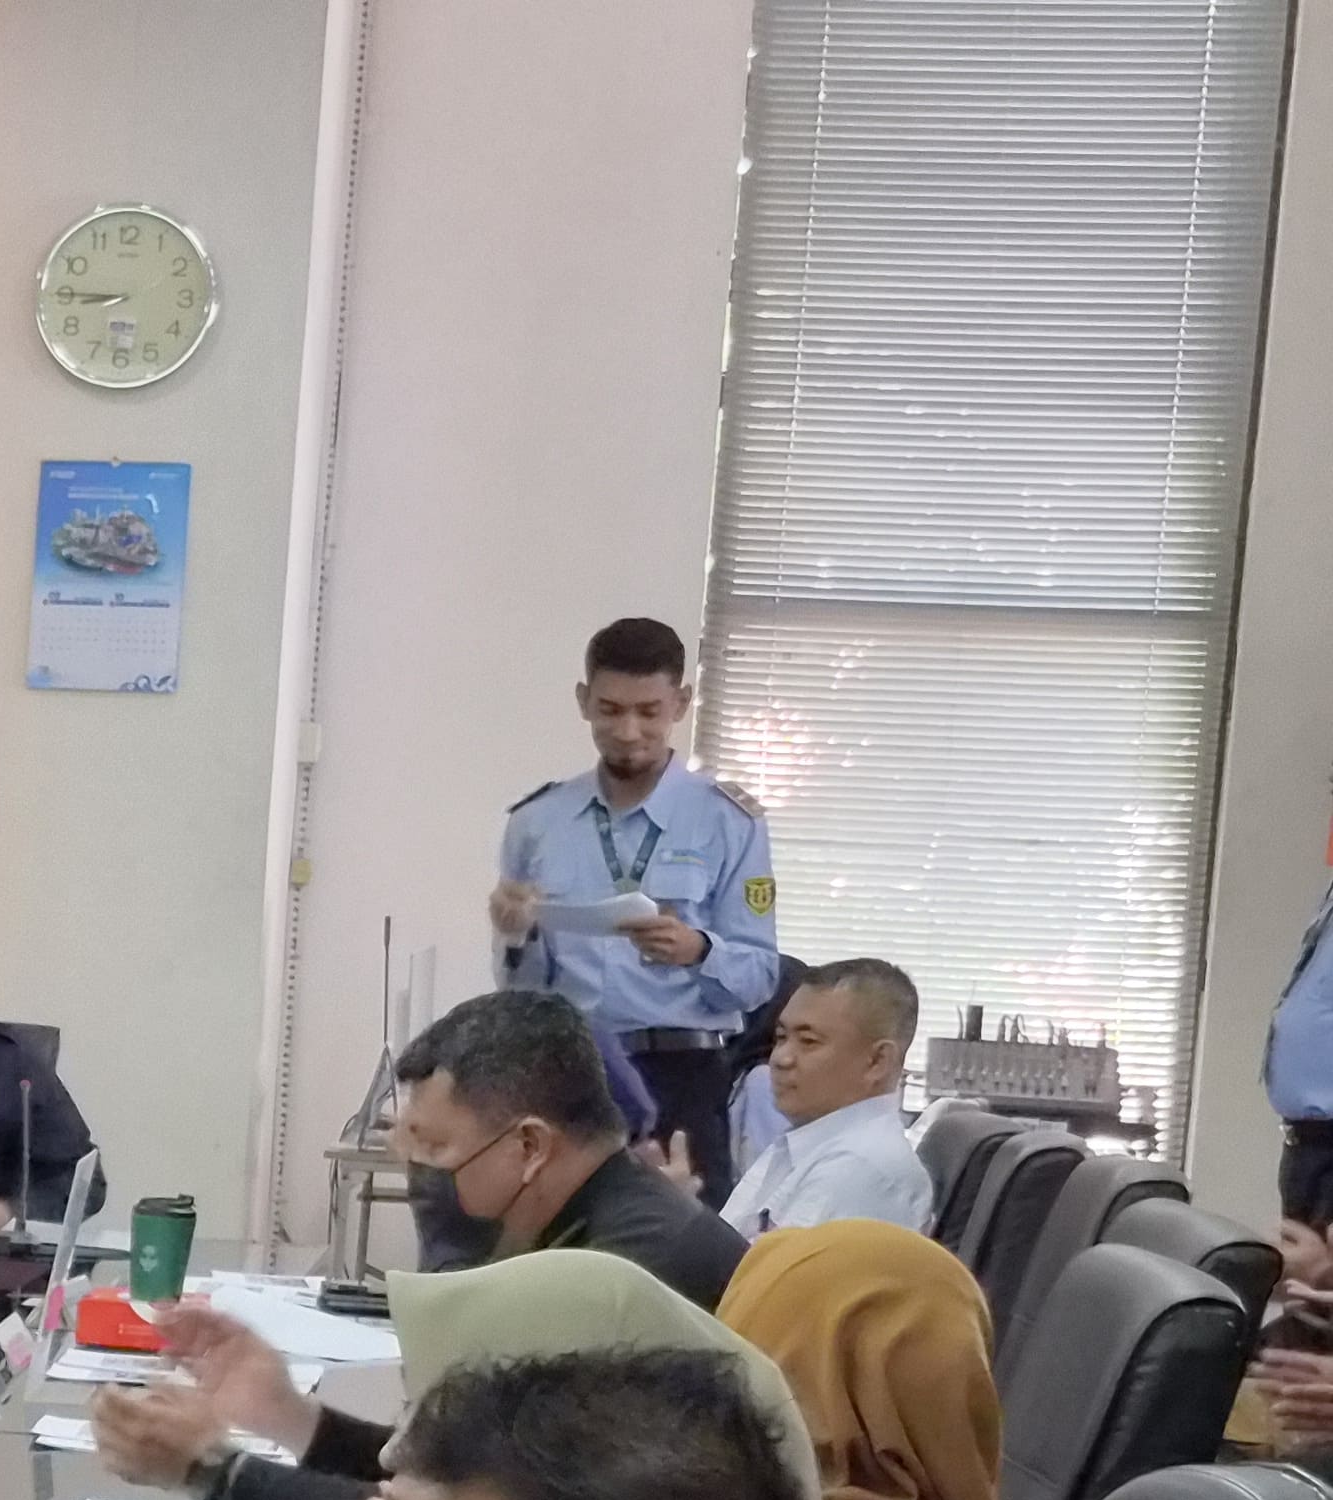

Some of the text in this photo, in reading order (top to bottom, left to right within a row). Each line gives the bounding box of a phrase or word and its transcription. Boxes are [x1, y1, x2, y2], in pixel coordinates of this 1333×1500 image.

[92, 231, 107, 251] 11
[120, 226, 140, 245] 12
[66, 256, 88, 276] 10
[172, 257, 188, 277] 2
[57, 286, 74, 305] 9
[177, 289, 194, 308] 3
[63, 316, 79, 336] 8
[166, 319, 181, 339] 4
[87, 341, 102, 360] 7
[112, 349, 130, 369] 6
[142, 343, 159, 362] 5
